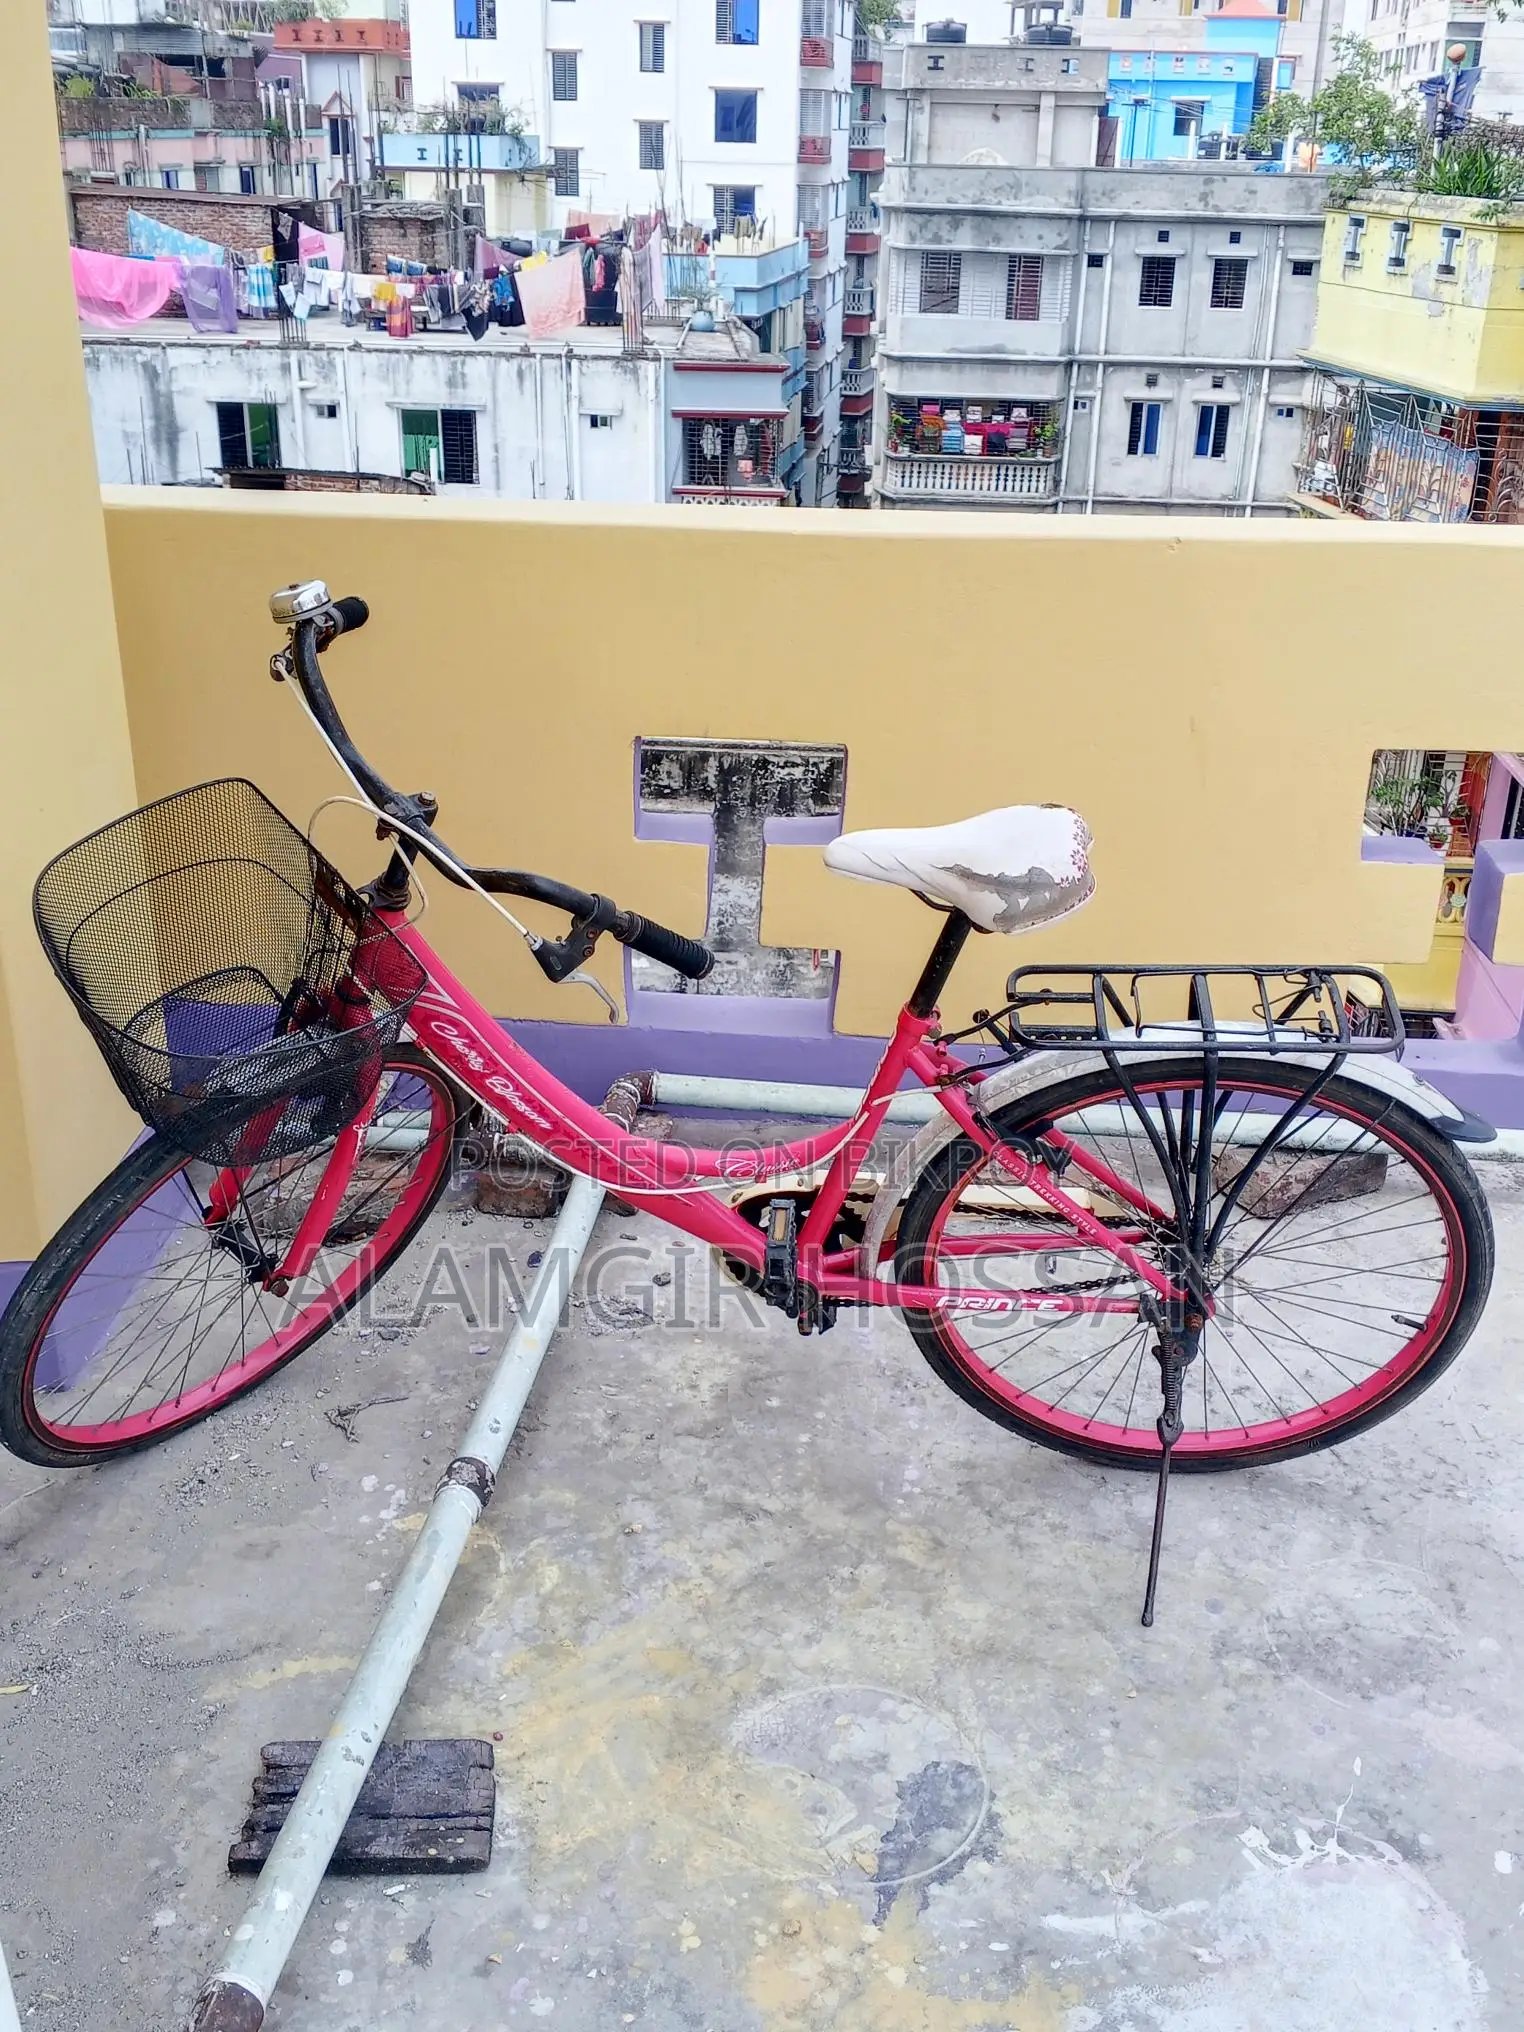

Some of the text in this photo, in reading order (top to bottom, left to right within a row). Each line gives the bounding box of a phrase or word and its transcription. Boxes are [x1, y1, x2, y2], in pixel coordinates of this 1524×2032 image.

[485, 1076, 553, 1130] Blossom
[993, 1150, 1098, 1235] CLASSIC TREKKING STYLE
[935, 1295, 1064, 1312] PRINCE
